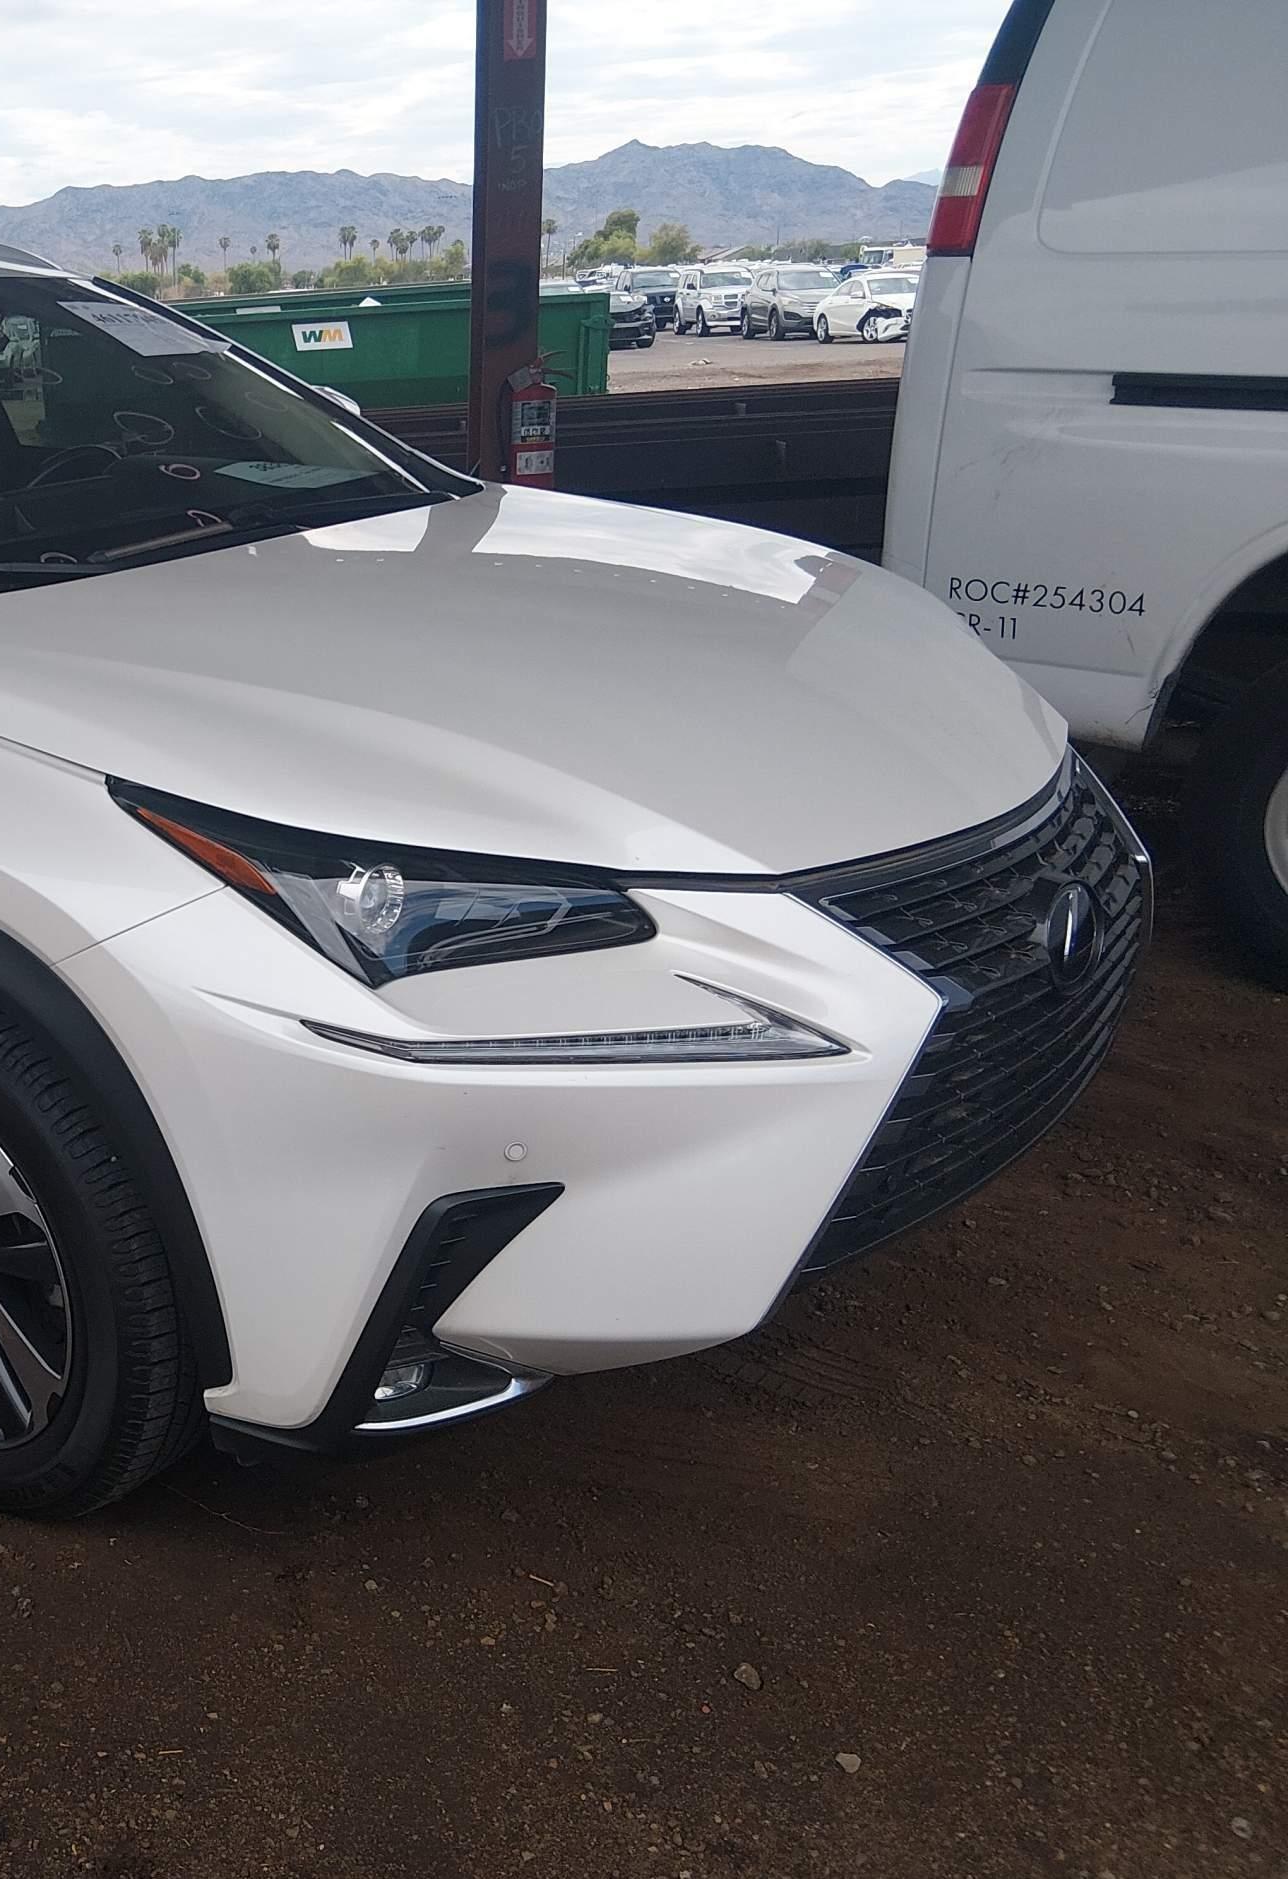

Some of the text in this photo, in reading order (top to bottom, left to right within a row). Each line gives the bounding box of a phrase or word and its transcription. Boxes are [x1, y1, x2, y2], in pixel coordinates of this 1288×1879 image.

[301, 327, 344, 344] WM
[948, 576, 1146, 617] ROC#254304
[956, 611, 1018, 641] R-11
